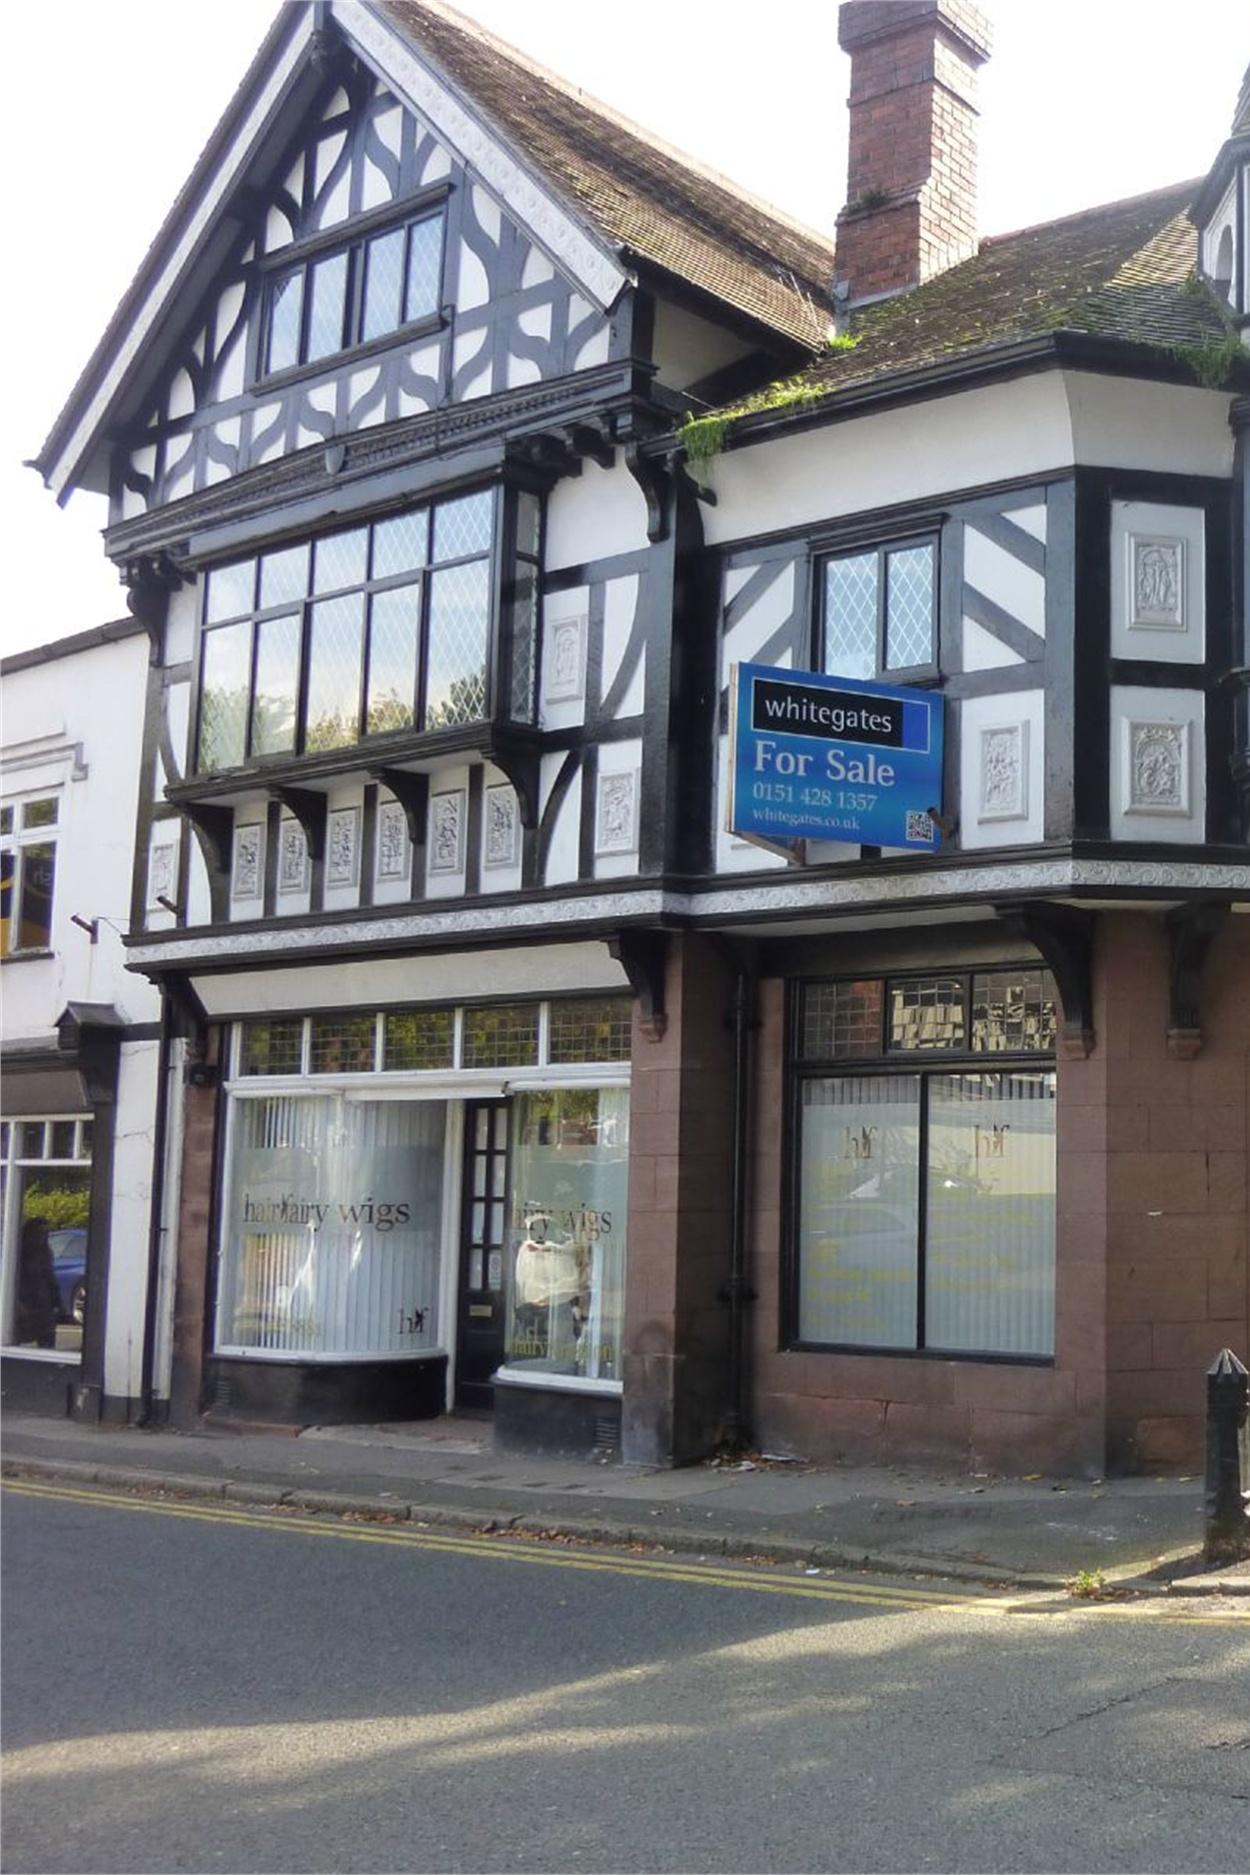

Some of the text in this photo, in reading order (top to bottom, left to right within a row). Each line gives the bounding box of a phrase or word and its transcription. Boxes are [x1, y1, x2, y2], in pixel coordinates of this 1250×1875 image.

[764, 695, 893, 733] whitegates
[753, 739, 896, 788] For Sale
[752, 781, 878, 812] 0151 428 1357
[752, 807, 861, 831] whitegates.co.uk
[338, 1197, 411, 1232] wigs
